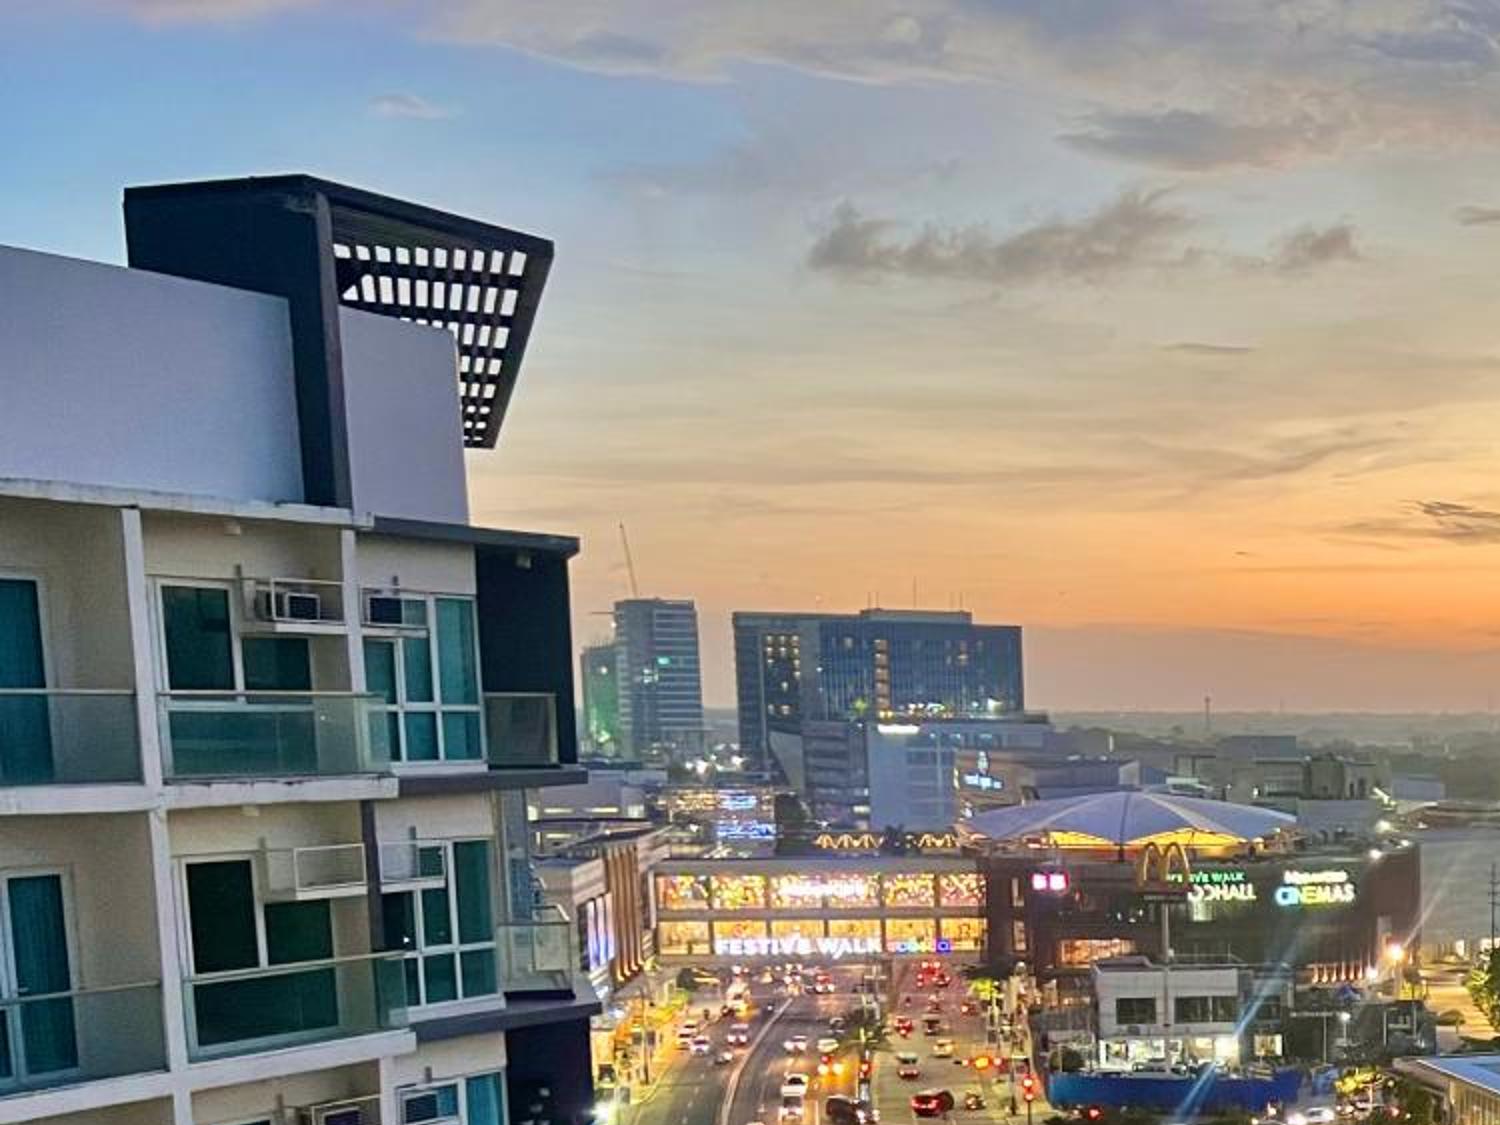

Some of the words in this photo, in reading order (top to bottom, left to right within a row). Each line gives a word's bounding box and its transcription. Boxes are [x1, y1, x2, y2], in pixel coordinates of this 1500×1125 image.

[1211, 871, 1245, 883] WALK
[1274, 883, 1355, 906] CINEMAS
[713, 935, 813, 955] FESTIVE
[816, 936, 883, 959] WALK
